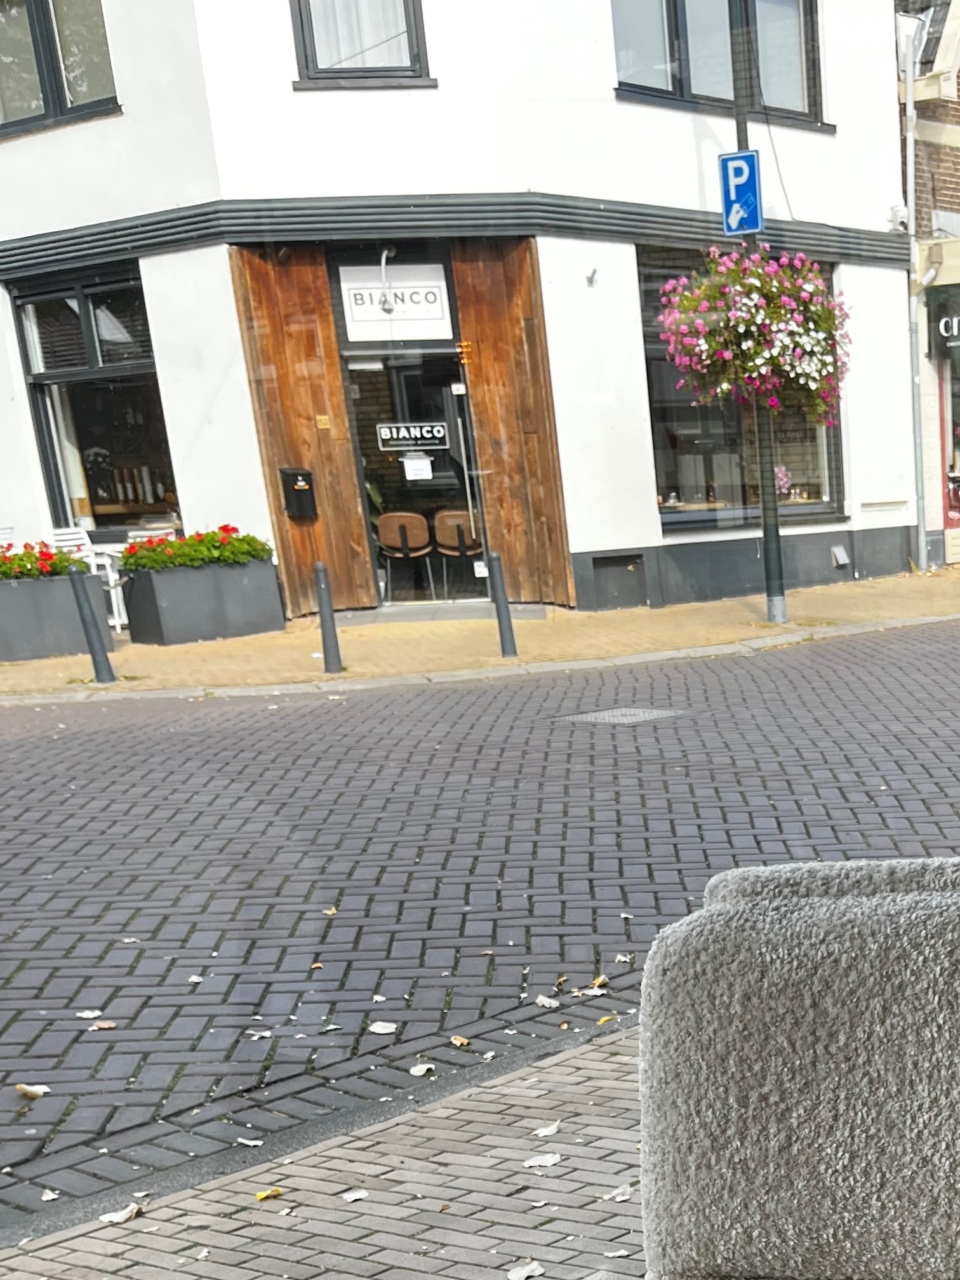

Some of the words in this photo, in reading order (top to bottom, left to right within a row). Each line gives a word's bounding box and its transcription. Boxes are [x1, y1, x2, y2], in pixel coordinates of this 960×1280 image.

[727, 160, 750, 201] P
[353, 290, 438, 307] BIANCO
[380, 425, 445, 440] BIANCO
